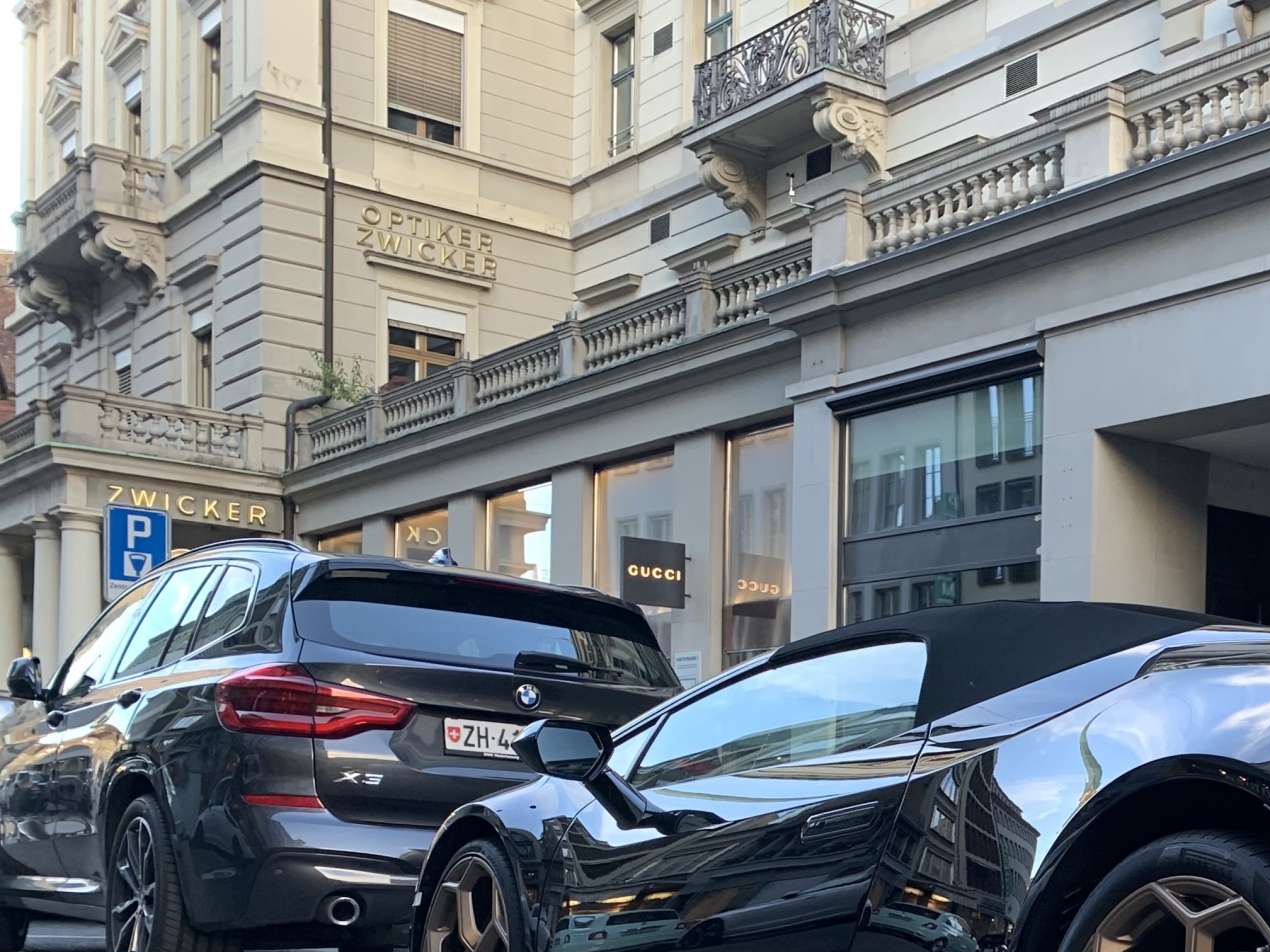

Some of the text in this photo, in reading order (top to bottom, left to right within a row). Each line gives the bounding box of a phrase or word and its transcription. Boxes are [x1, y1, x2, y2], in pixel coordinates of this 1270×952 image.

[361, 204, 493, 254] OPTIKER
[356, 226, 498, 277] ZWICKER
[108, 485, 267, 526] ZWICKER
[127, 514, 151, 549] P
[628, 564, 682, 581] GUCCI
[333, 771, 384, 786] X3
